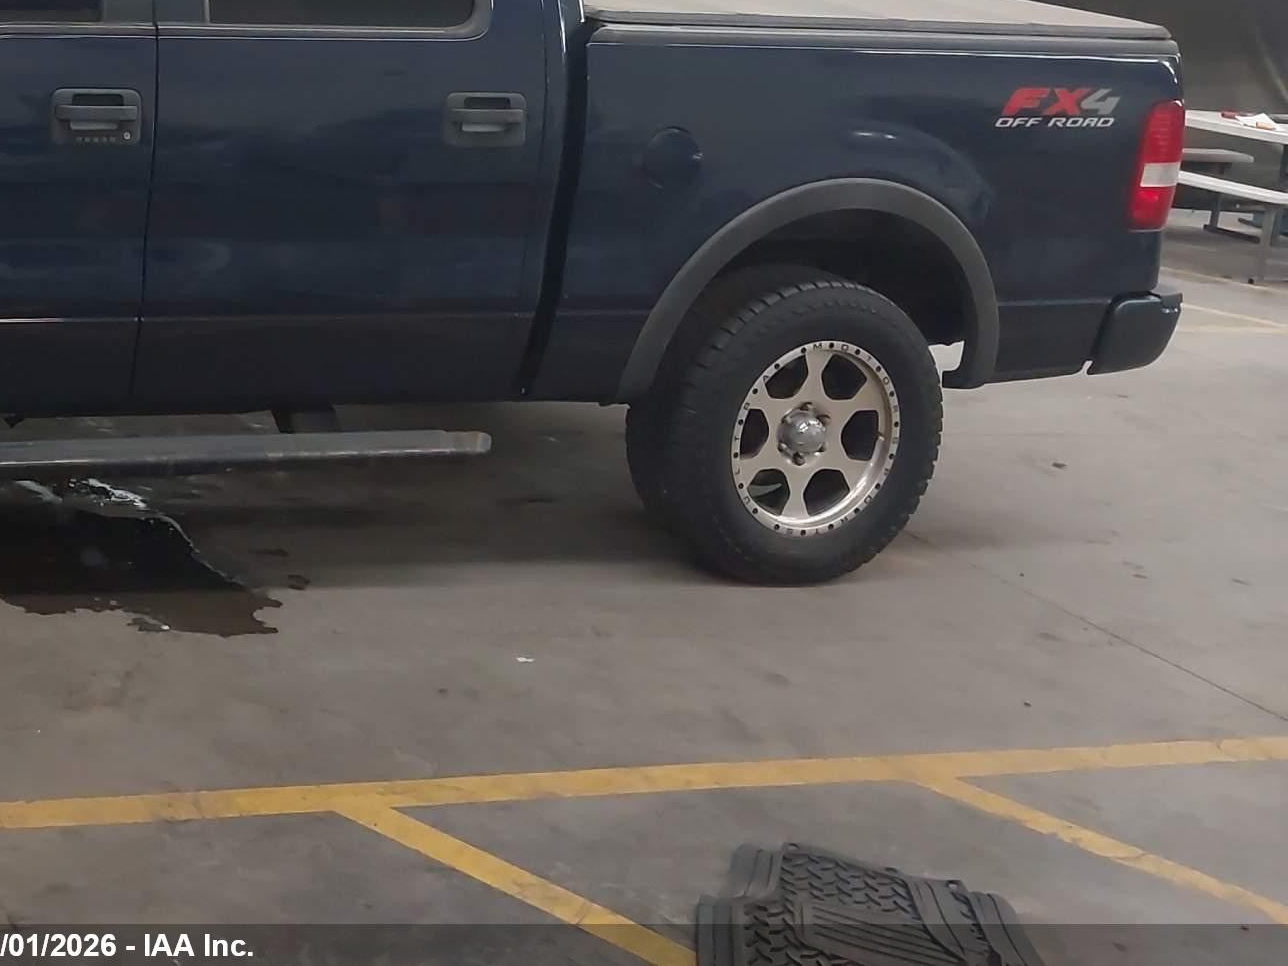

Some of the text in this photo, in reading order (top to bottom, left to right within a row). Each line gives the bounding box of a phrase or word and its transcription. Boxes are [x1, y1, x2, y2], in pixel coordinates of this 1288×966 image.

[1002, 87, 1121, 115] FX4
[995, 117, 1115, 128] OFF ROAD
